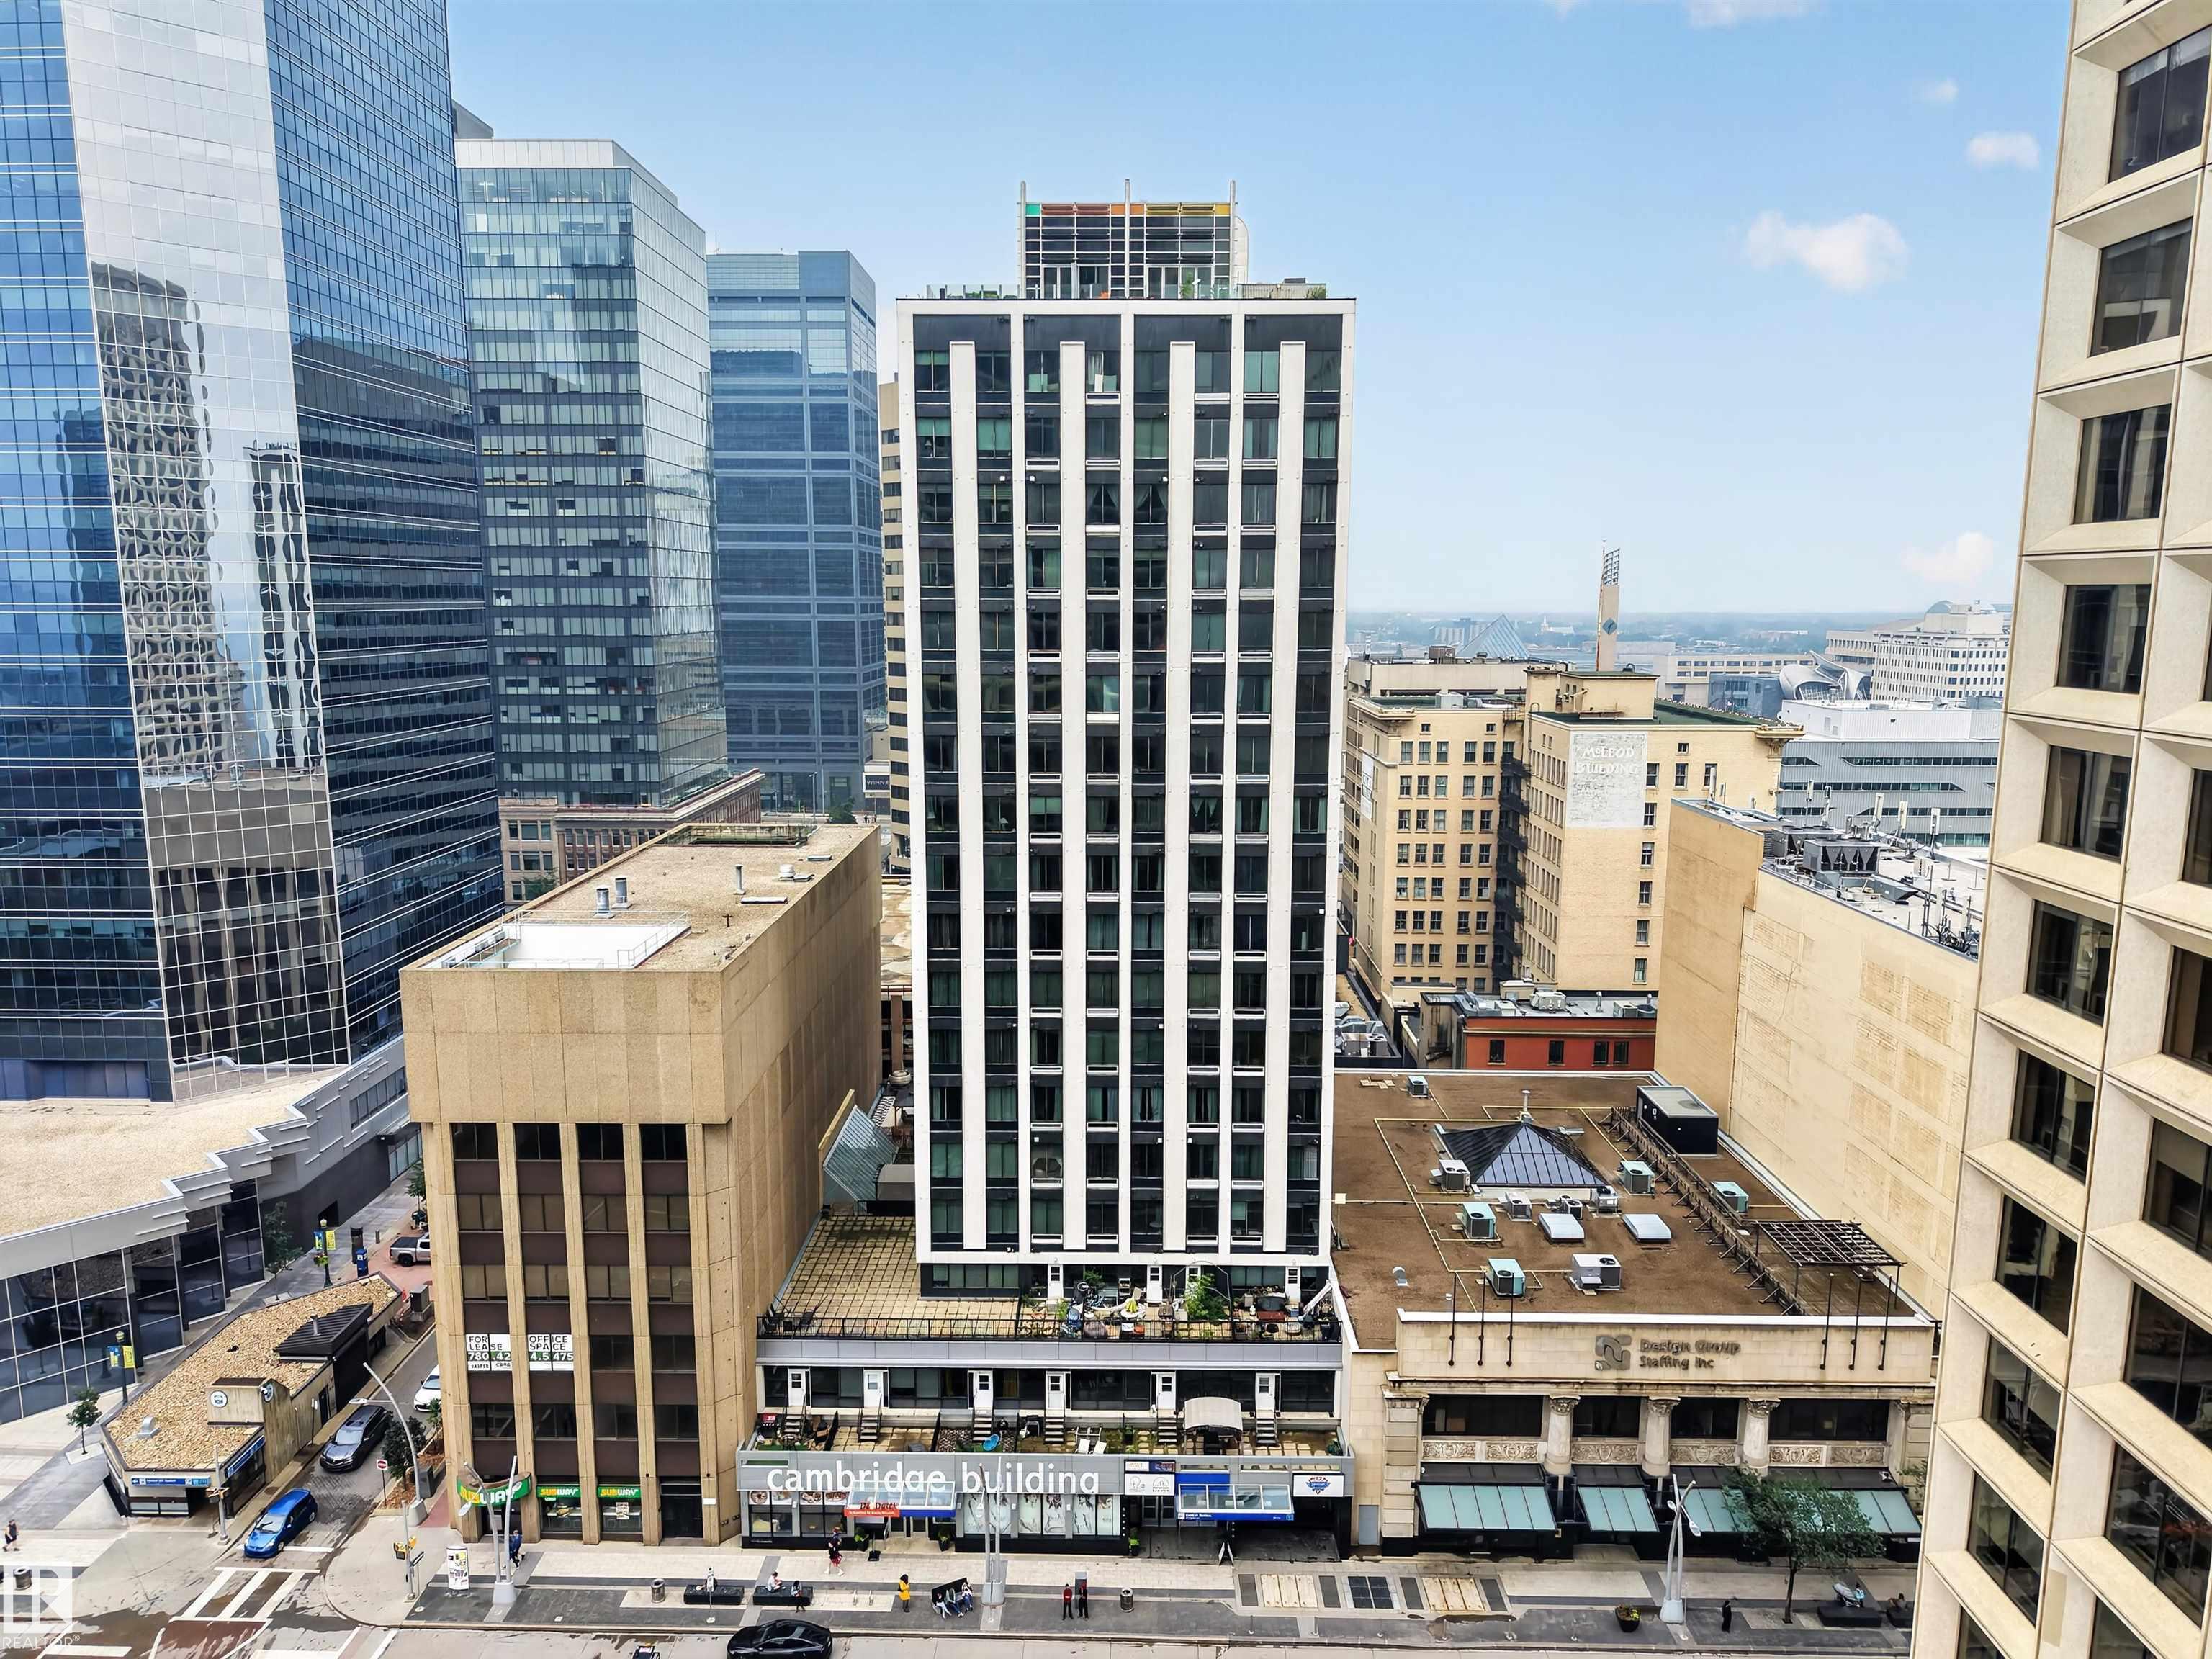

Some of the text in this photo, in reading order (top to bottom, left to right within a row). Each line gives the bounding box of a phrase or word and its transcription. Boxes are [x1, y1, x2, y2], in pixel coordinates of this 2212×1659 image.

[1575, 762, 1638, 774] BUILDING
[1640, 1339, 1741, 1355] Design Group
[1640, 1355, 1714, 1370] Staffing Inc
[767, 1460, 1099, 1493] cambridge building
[460, 1481, 522, 1504] SUBWAY
[541, 1488, 579, 1496] SUBWAY
